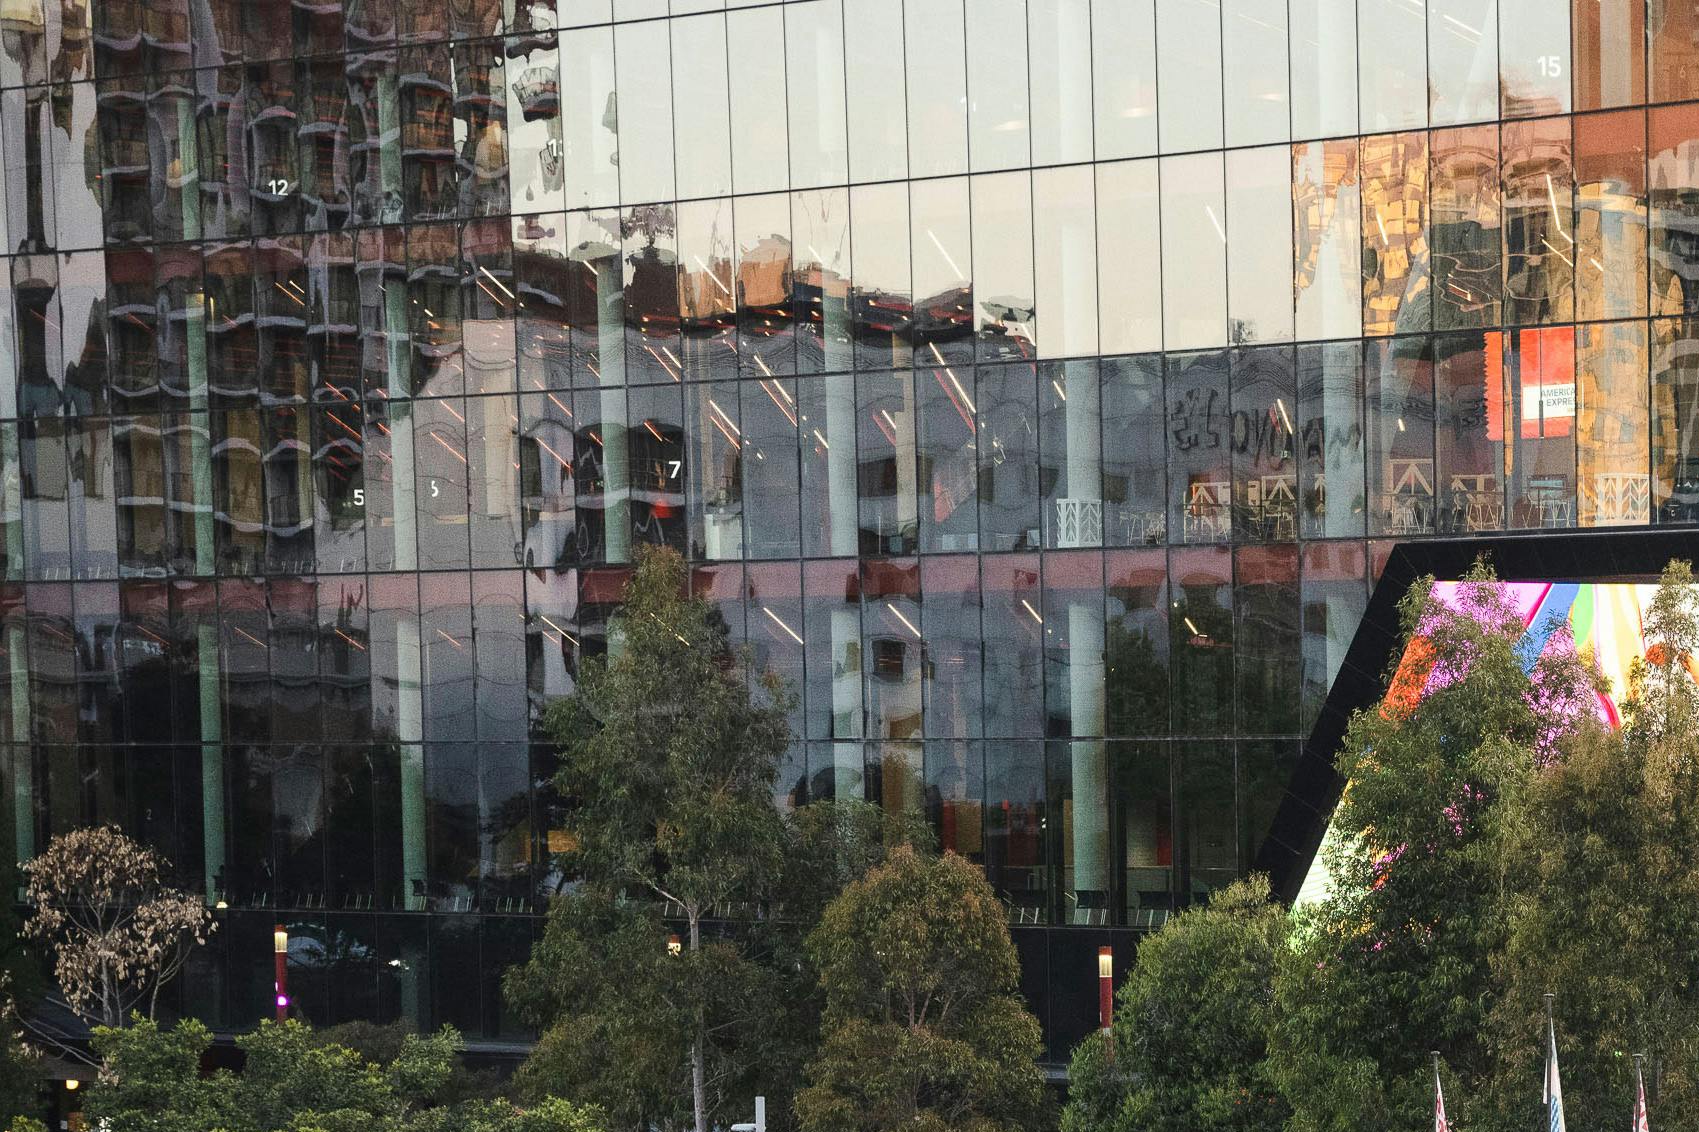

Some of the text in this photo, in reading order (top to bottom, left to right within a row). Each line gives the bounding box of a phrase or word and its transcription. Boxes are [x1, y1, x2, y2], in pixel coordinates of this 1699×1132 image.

[1537, 55, 1562, 78] 15
[268, 179, 289, 196] 12
[668, 460, 682, 479] 7
[353, 488, 365, 506] 5
